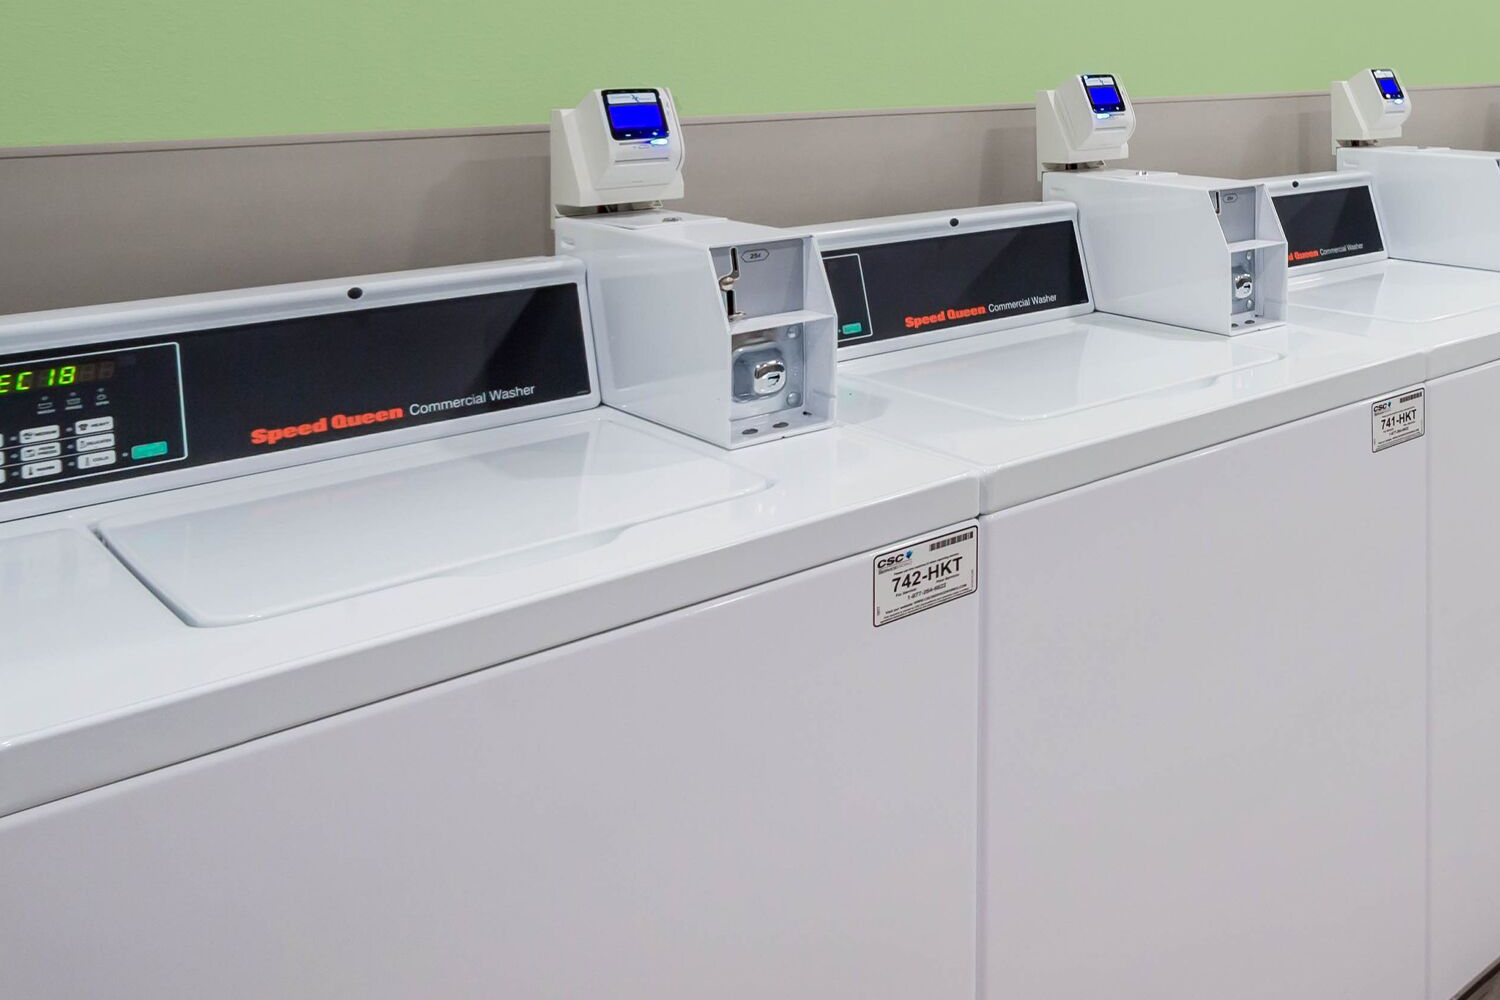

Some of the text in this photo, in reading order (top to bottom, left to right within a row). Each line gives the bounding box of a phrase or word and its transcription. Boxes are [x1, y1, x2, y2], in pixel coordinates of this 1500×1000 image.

[905, 293, 1057, 328] Speed Queen Commercial Washer
[47, 365, 77, 387] 18
[251, 384, 536, 444] Speed Queen Commercial Washer
[1380, 408, 1417, 430] 741-HKT
[878, 554, 904, 568] CSC
[891, 555, 963, 593] 742-HKT
